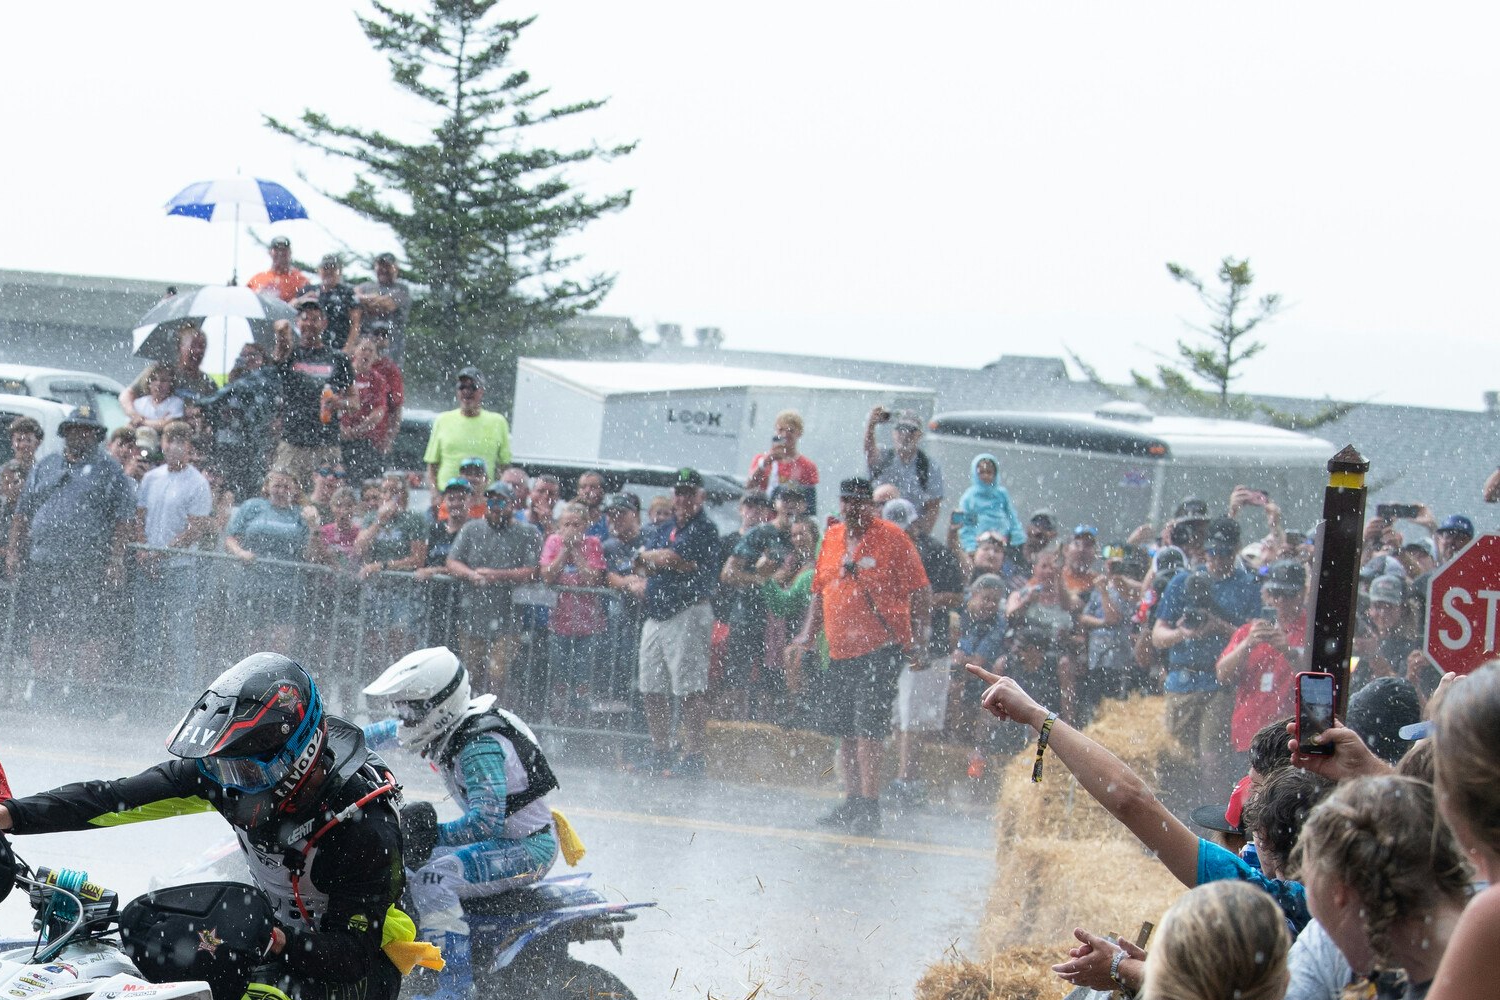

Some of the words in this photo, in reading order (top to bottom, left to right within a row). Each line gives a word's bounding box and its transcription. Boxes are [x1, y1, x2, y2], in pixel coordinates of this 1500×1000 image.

[668, 409, 722, 427] LOOK
[178, 725, 217, 747] FLY
[423, 872, 445, 885] FLY
